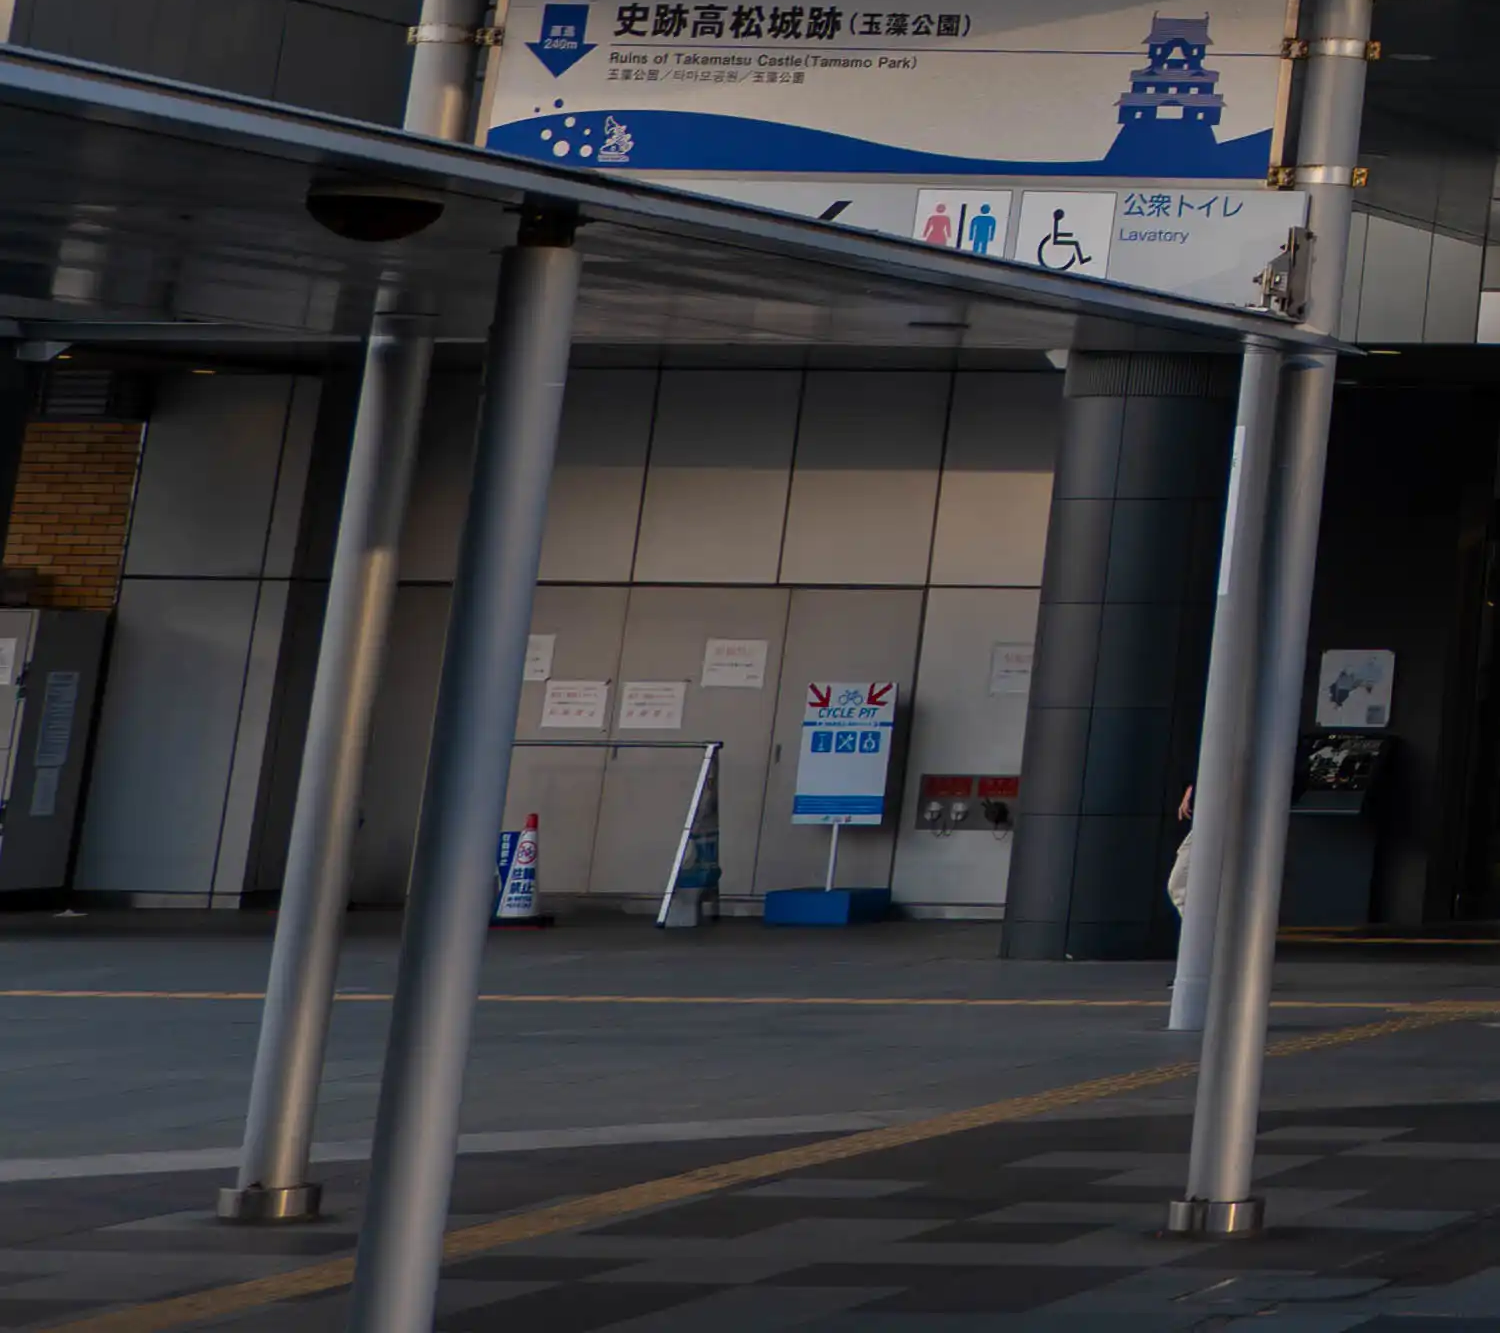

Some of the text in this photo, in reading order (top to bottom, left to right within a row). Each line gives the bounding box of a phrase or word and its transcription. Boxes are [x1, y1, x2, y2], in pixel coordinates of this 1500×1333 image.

[609, 52, 649, 64] Ruins
[653, 52, 669, 65] of
[674, 53, 752, 66] Takamatsu
[878, 56, 918, 70] Park)
[1123, 192, 1244, 218] 公衆トイレ
[1119, 228, 1190, 244] Lavatory
[818, 707, 880, 719] CYCLE PIT
